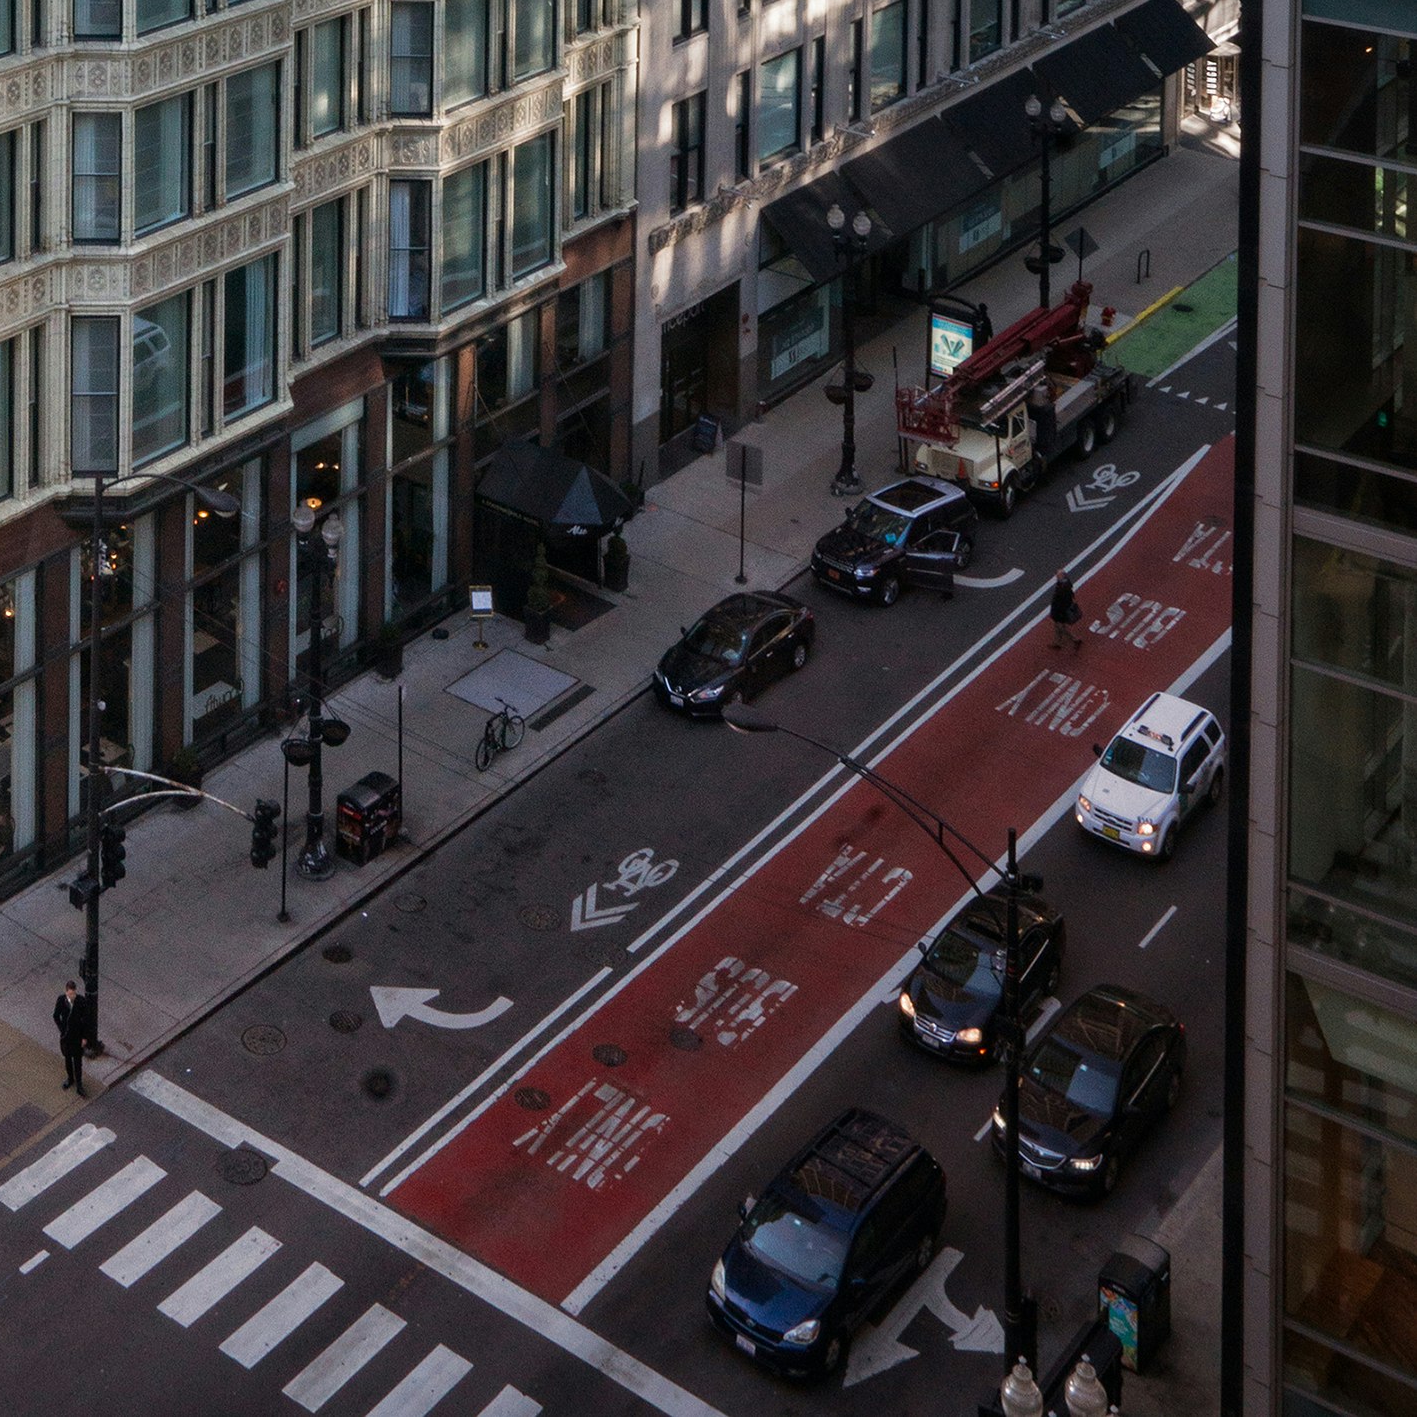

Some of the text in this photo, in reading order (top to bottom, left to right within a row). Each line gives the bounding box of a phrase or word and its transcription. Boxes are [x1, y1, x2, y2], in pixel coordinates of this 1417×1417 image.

[1088, 592, 1187, 651] BUS
[995, 669, 1110, 737] ONLY
[799, 843, 913, 927] CTA
[674, 956, 799, 1049] BUS
[512, 1077, 671, 1189] ONLY
